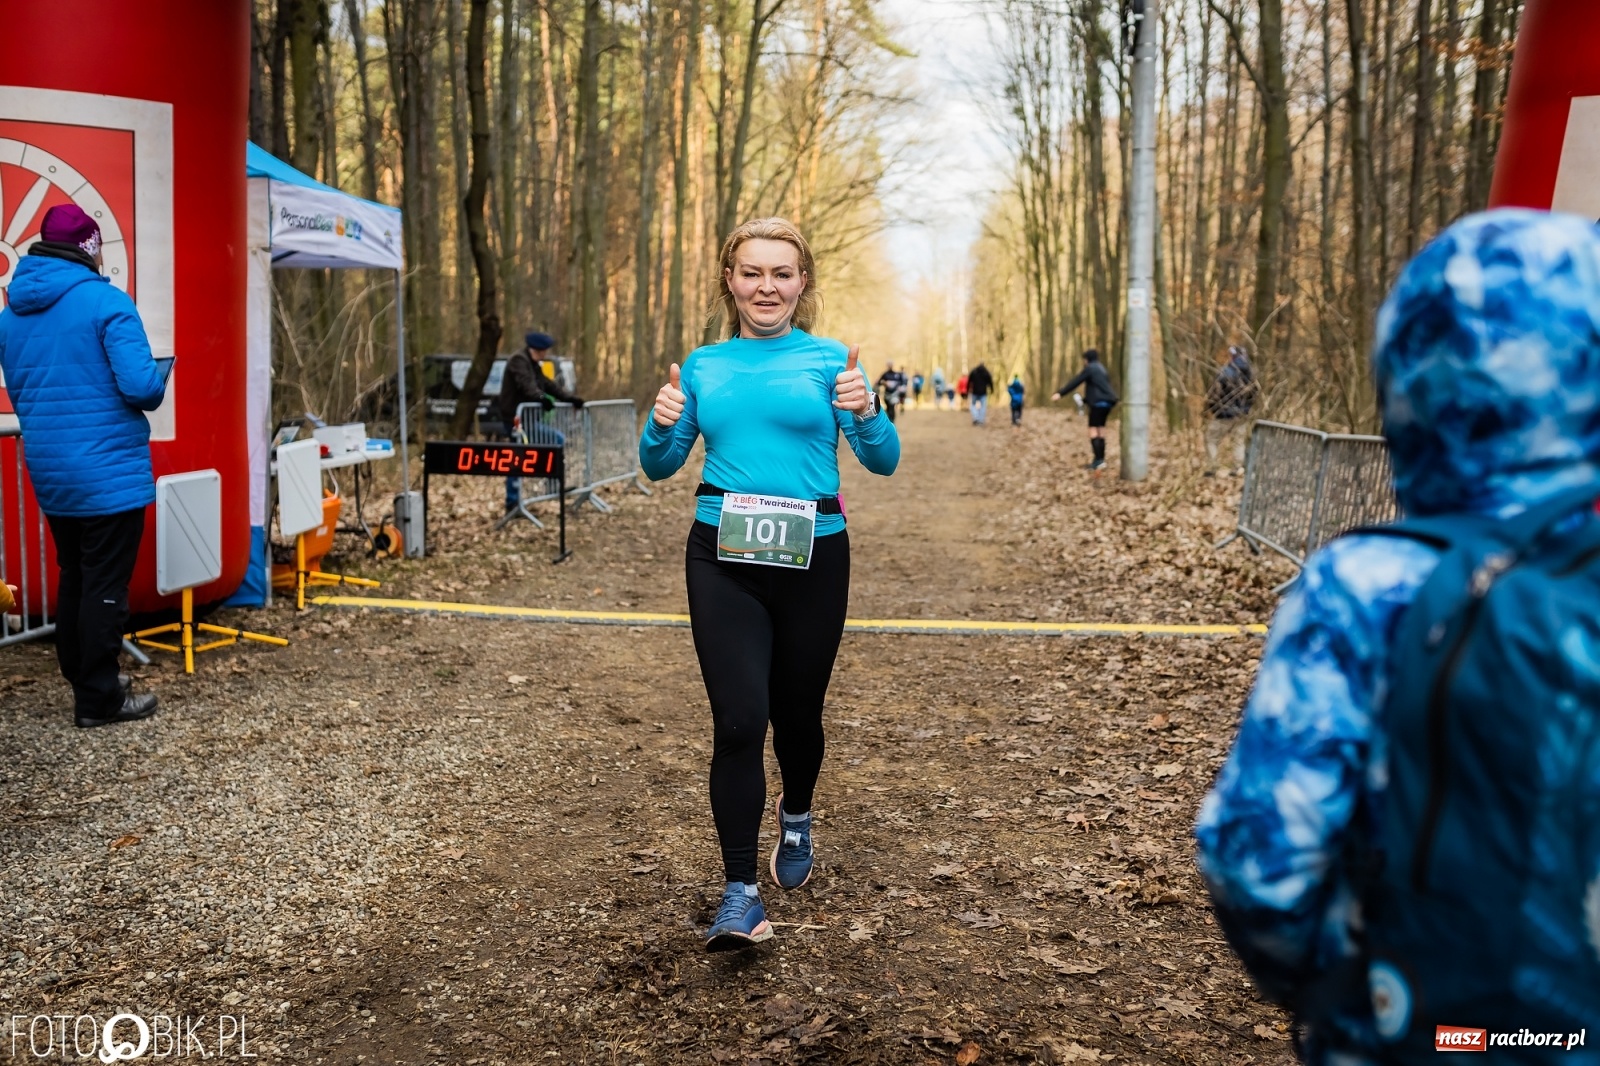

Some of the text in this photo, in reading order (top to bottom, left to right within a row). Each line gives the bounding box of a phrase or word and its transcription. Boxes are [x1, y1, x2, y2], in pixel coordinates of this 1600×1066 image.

[458, 447, 553, 473] 0:42:21
[740, 496, 758, 504] BIEG
[759, 498, 806, 511] Twardziela
[744, 517, 788, 546] 101
